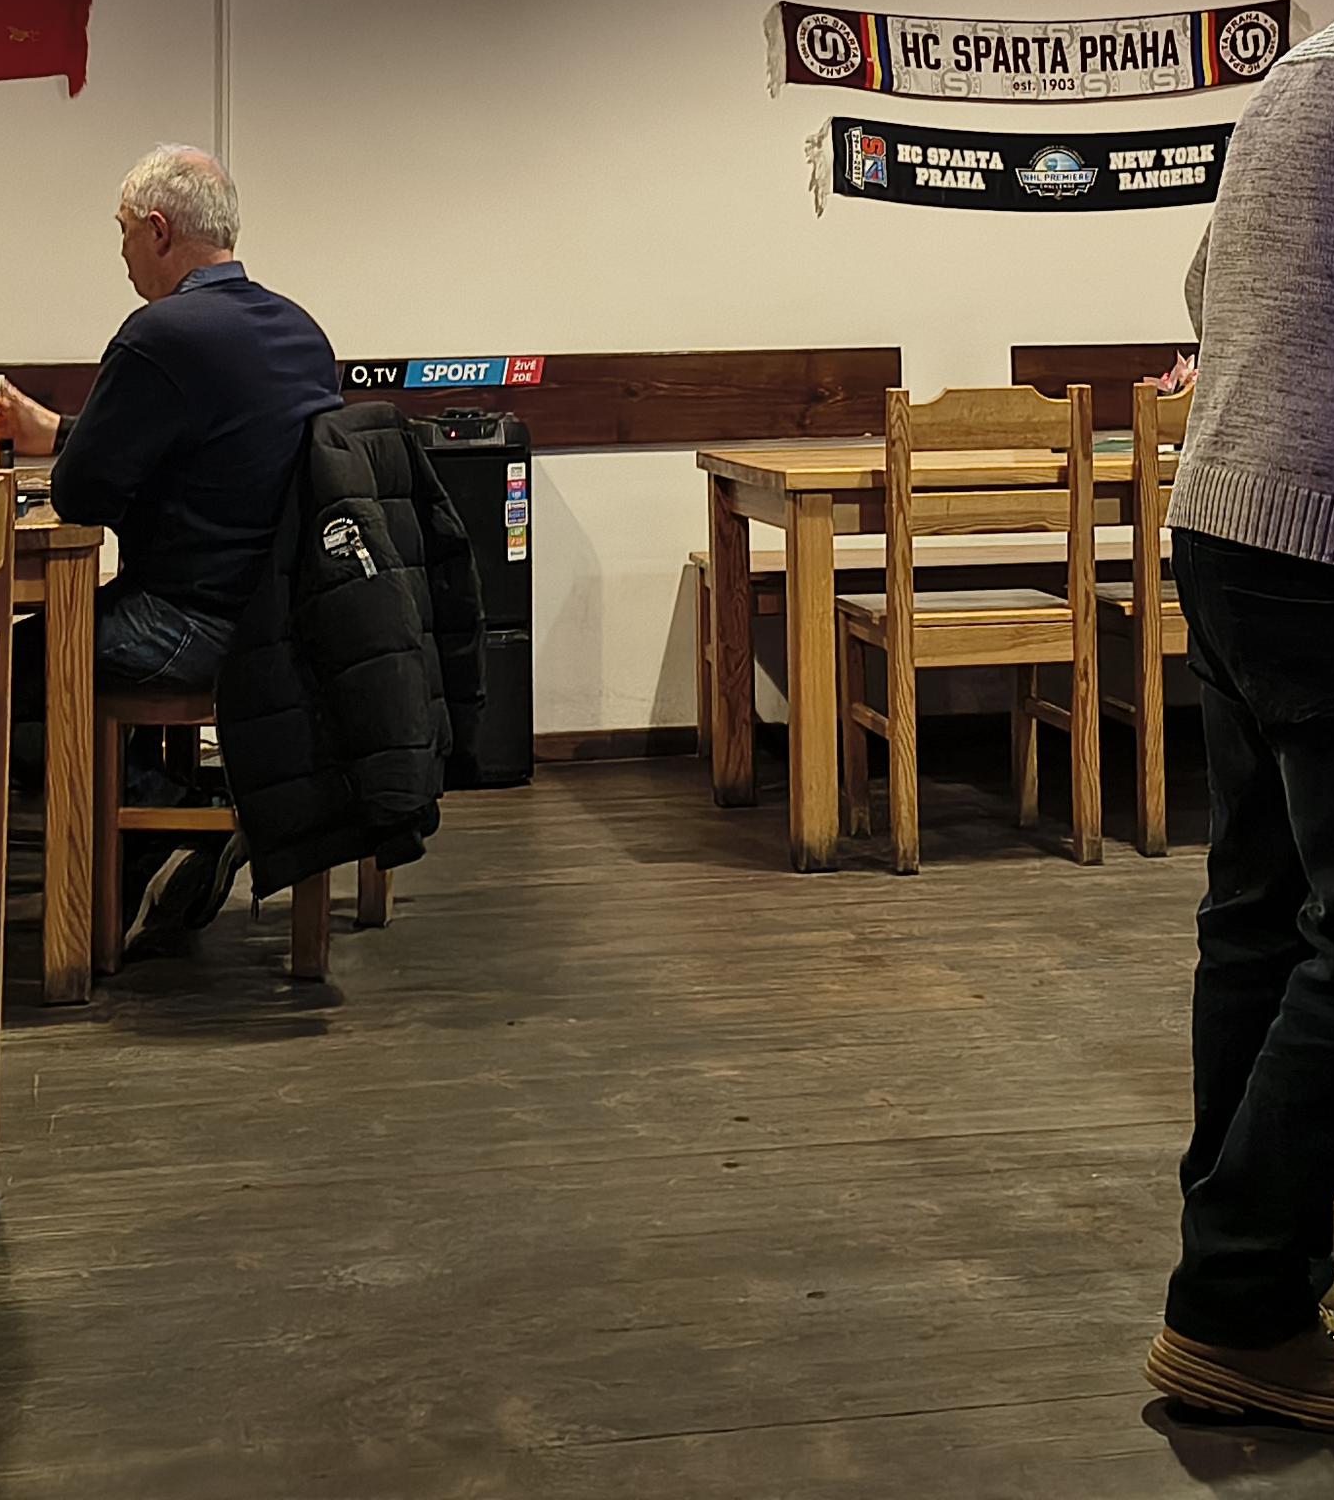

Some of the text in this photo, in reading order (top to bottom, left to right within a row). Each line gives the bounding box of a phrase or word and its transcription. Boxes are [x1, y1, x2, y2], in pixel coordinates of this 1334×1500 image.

[901, 28, 1180, 74] HC SPARTA PRAHA
[1042, 78, 1076, 91] 1903
[897, 143, 923, 166] HC
[927, 147, 1004, 172] SPARTA
[1109, 148, 1157, 171] NEW
[1161, 143, 1215, 166] YORK
[916, 168, 986, 191] PRAHA
[1118, 168, 1205, 191] RANGERS
[421, 363, 490, 382] SPORT
